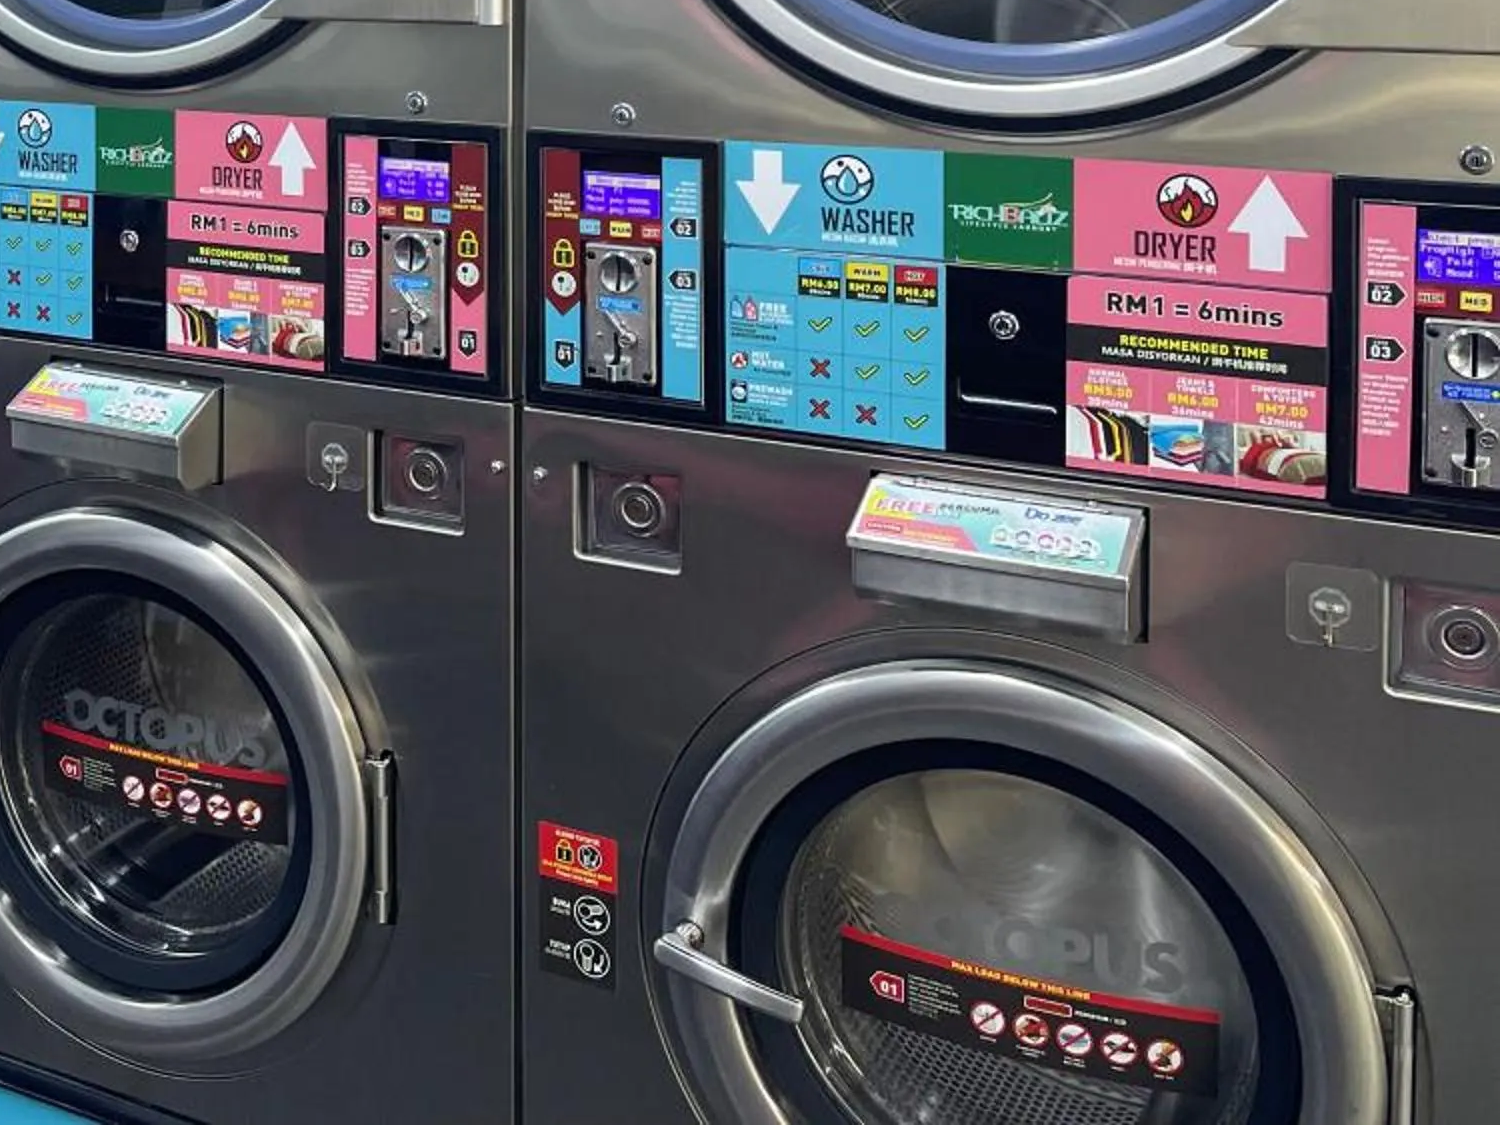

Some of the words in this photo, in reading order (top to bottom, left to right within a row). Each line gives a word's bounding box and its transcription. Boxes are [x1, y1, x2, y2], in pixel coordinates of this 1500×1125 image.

[18, 149, 79, 174] WASHER
[212, 166, 263, 191] DRYER
[247, 220, 299, 239] 6mins
[676, 223, 692, 236] 02
[821, 206, 915, 237] WASHER
[1135, 230, 1217, 263] DRYER
[1371, 289, 1393, 303] 02
[1199, 301, 1284, 328] 6mins
[1101, 345, 1134, 358] MASA
[1118, 334, 1230, 356] RECOMMENDED
[1233, 345, 1270, 360] TIME
[1370, 345, 1391, 359] 03
[876, 496, 935, 516] FREE
[879, 979, 898, 997] 01
